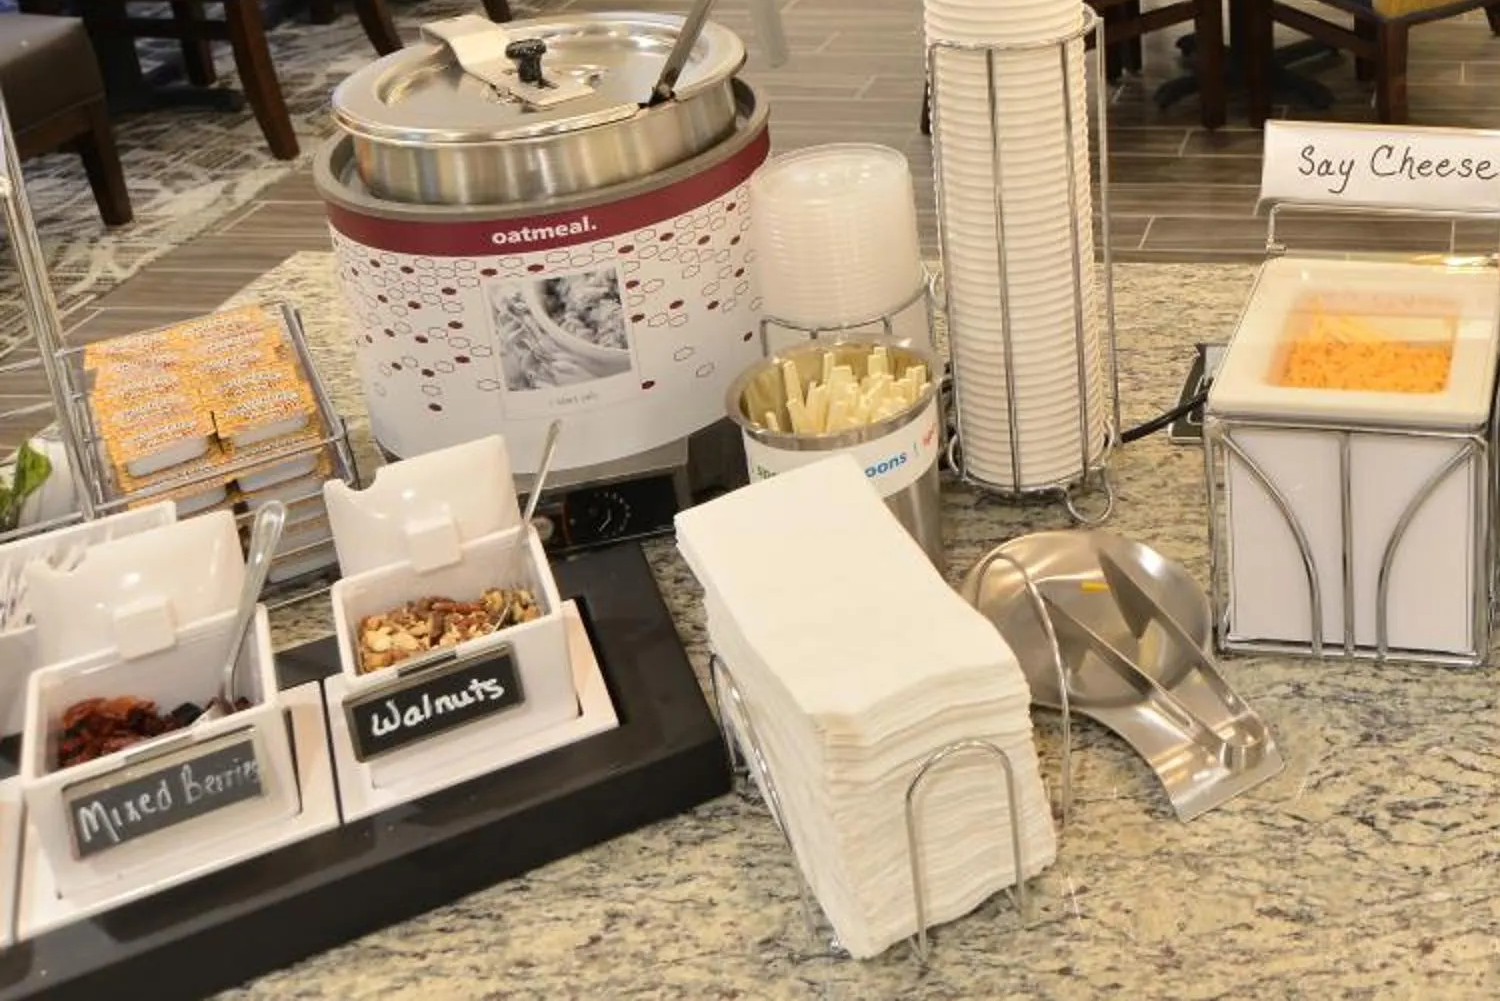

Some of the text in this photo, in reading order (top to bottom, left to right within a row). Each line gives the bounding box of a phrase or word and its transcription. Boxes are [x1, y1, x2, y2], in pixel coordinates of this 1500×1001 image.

[1298, 144, 1500, 194] Say Cheese
[491, 215, 597, 245] oatmeal.
[863, 451, 908, 478] oons
[371, 678, 505, 737] Walnuts
[78, 779, 173, 843] Mixed
